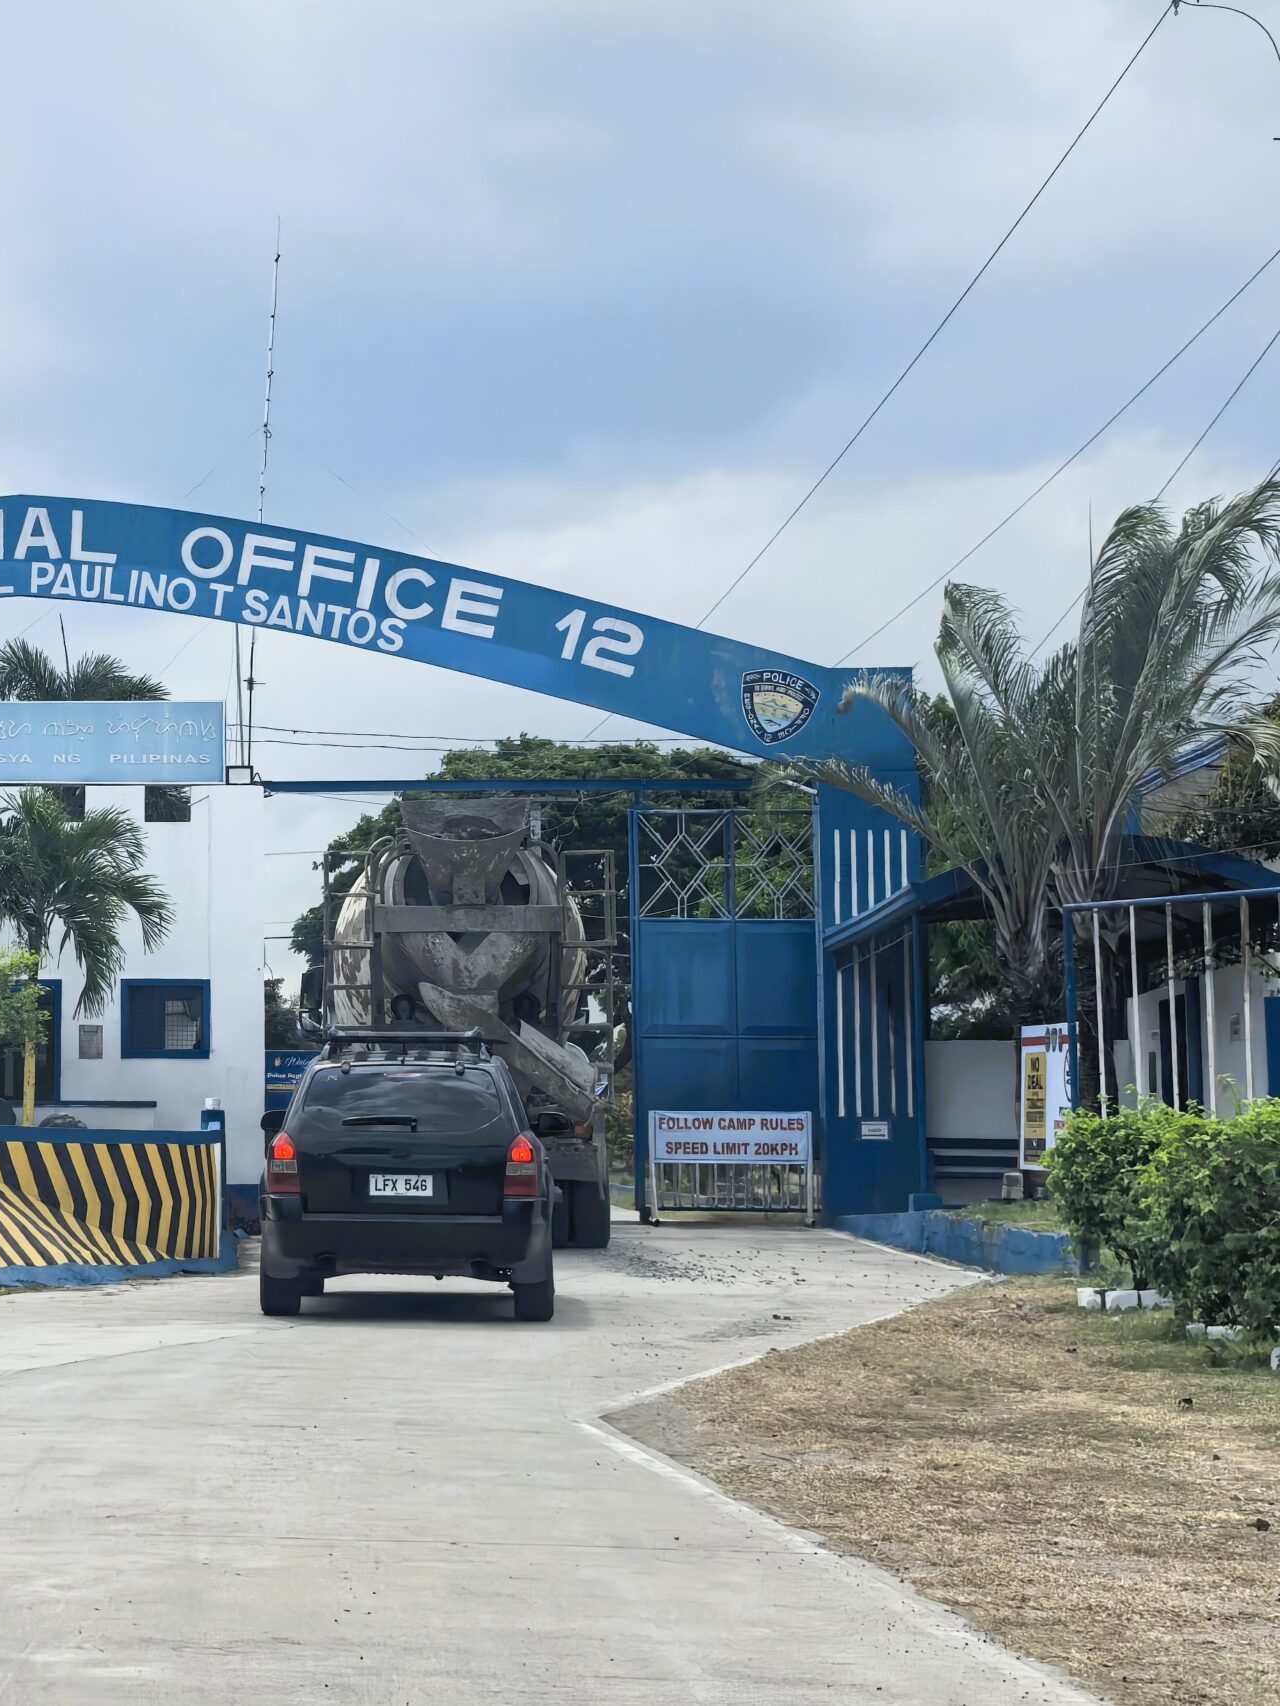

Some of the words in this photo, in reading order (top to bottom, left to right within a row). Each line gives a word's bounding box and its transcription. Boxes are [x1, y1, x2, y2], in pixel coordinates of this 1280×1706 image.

[30, 561, 197, 611] PAULINO
[209, 583, 234, 616] T
[241, 589, 408, 652] SANTOS
[181, 526, 504, 639] OFFICE
[555, 608, 644, 678] 12
[762, 672, 805, 691] POLICE
[763, 733, 773, 742] 12
[777, 708, 810, 739] OFFICE
[53, 753, 81, 764] NG
[109, 753, 210, 764] PILIPINAS
[658, 1117, 713, 1130] FOLLOW
[717, 1118, 756, 1131] CAMP
[760, 1118, 805, 1131] RULES
[665, 1142, 709, 1155] SPEED
[713, 1142, 750, 1155] LIMIT
[754, 1143, 799, 1156] 20KPH
[375, 1178, 398, 1191] LFX
[404, 1178, 427, 1191] 546
